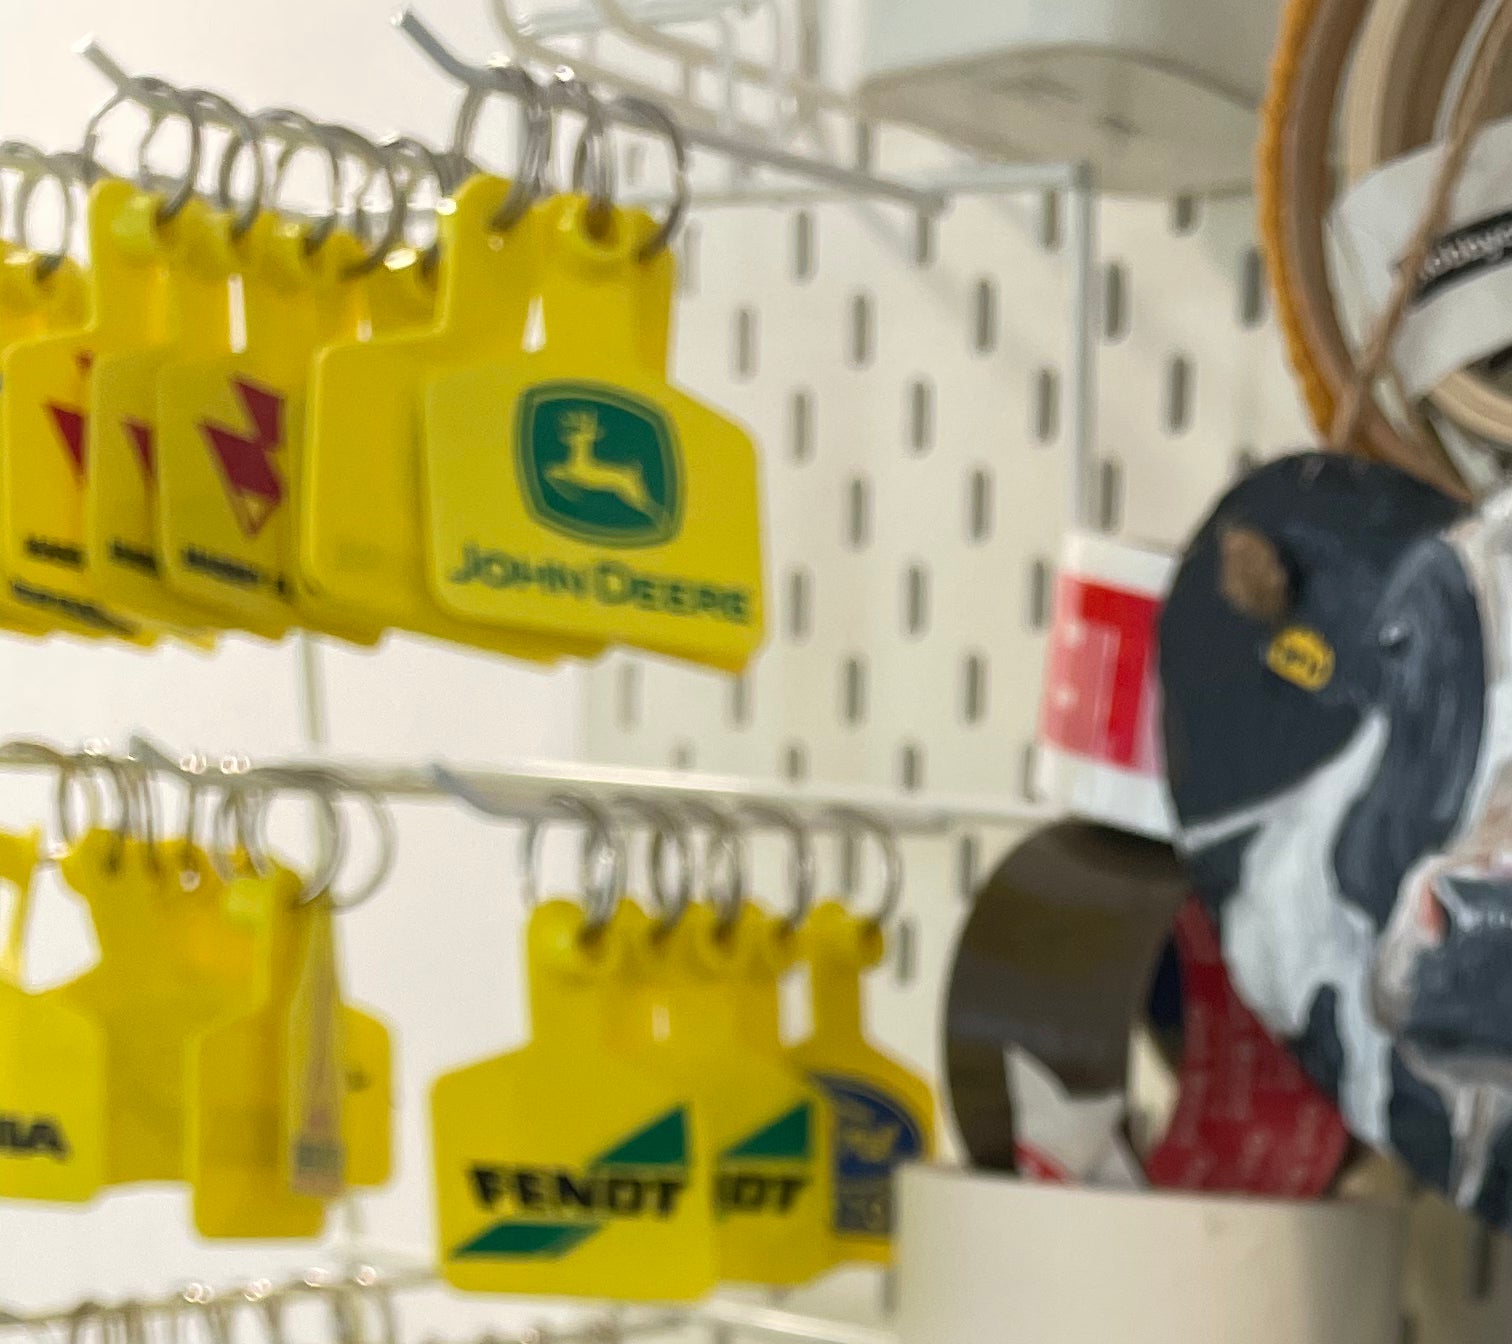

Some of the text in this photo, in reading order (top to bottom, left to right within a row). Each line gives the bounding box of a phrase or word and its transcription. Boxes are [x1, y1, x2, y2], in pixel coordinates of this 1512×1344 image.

[450, 541, 752, 626] JOHN DEERE
[471, 1160, 686, 1221] FENDT
